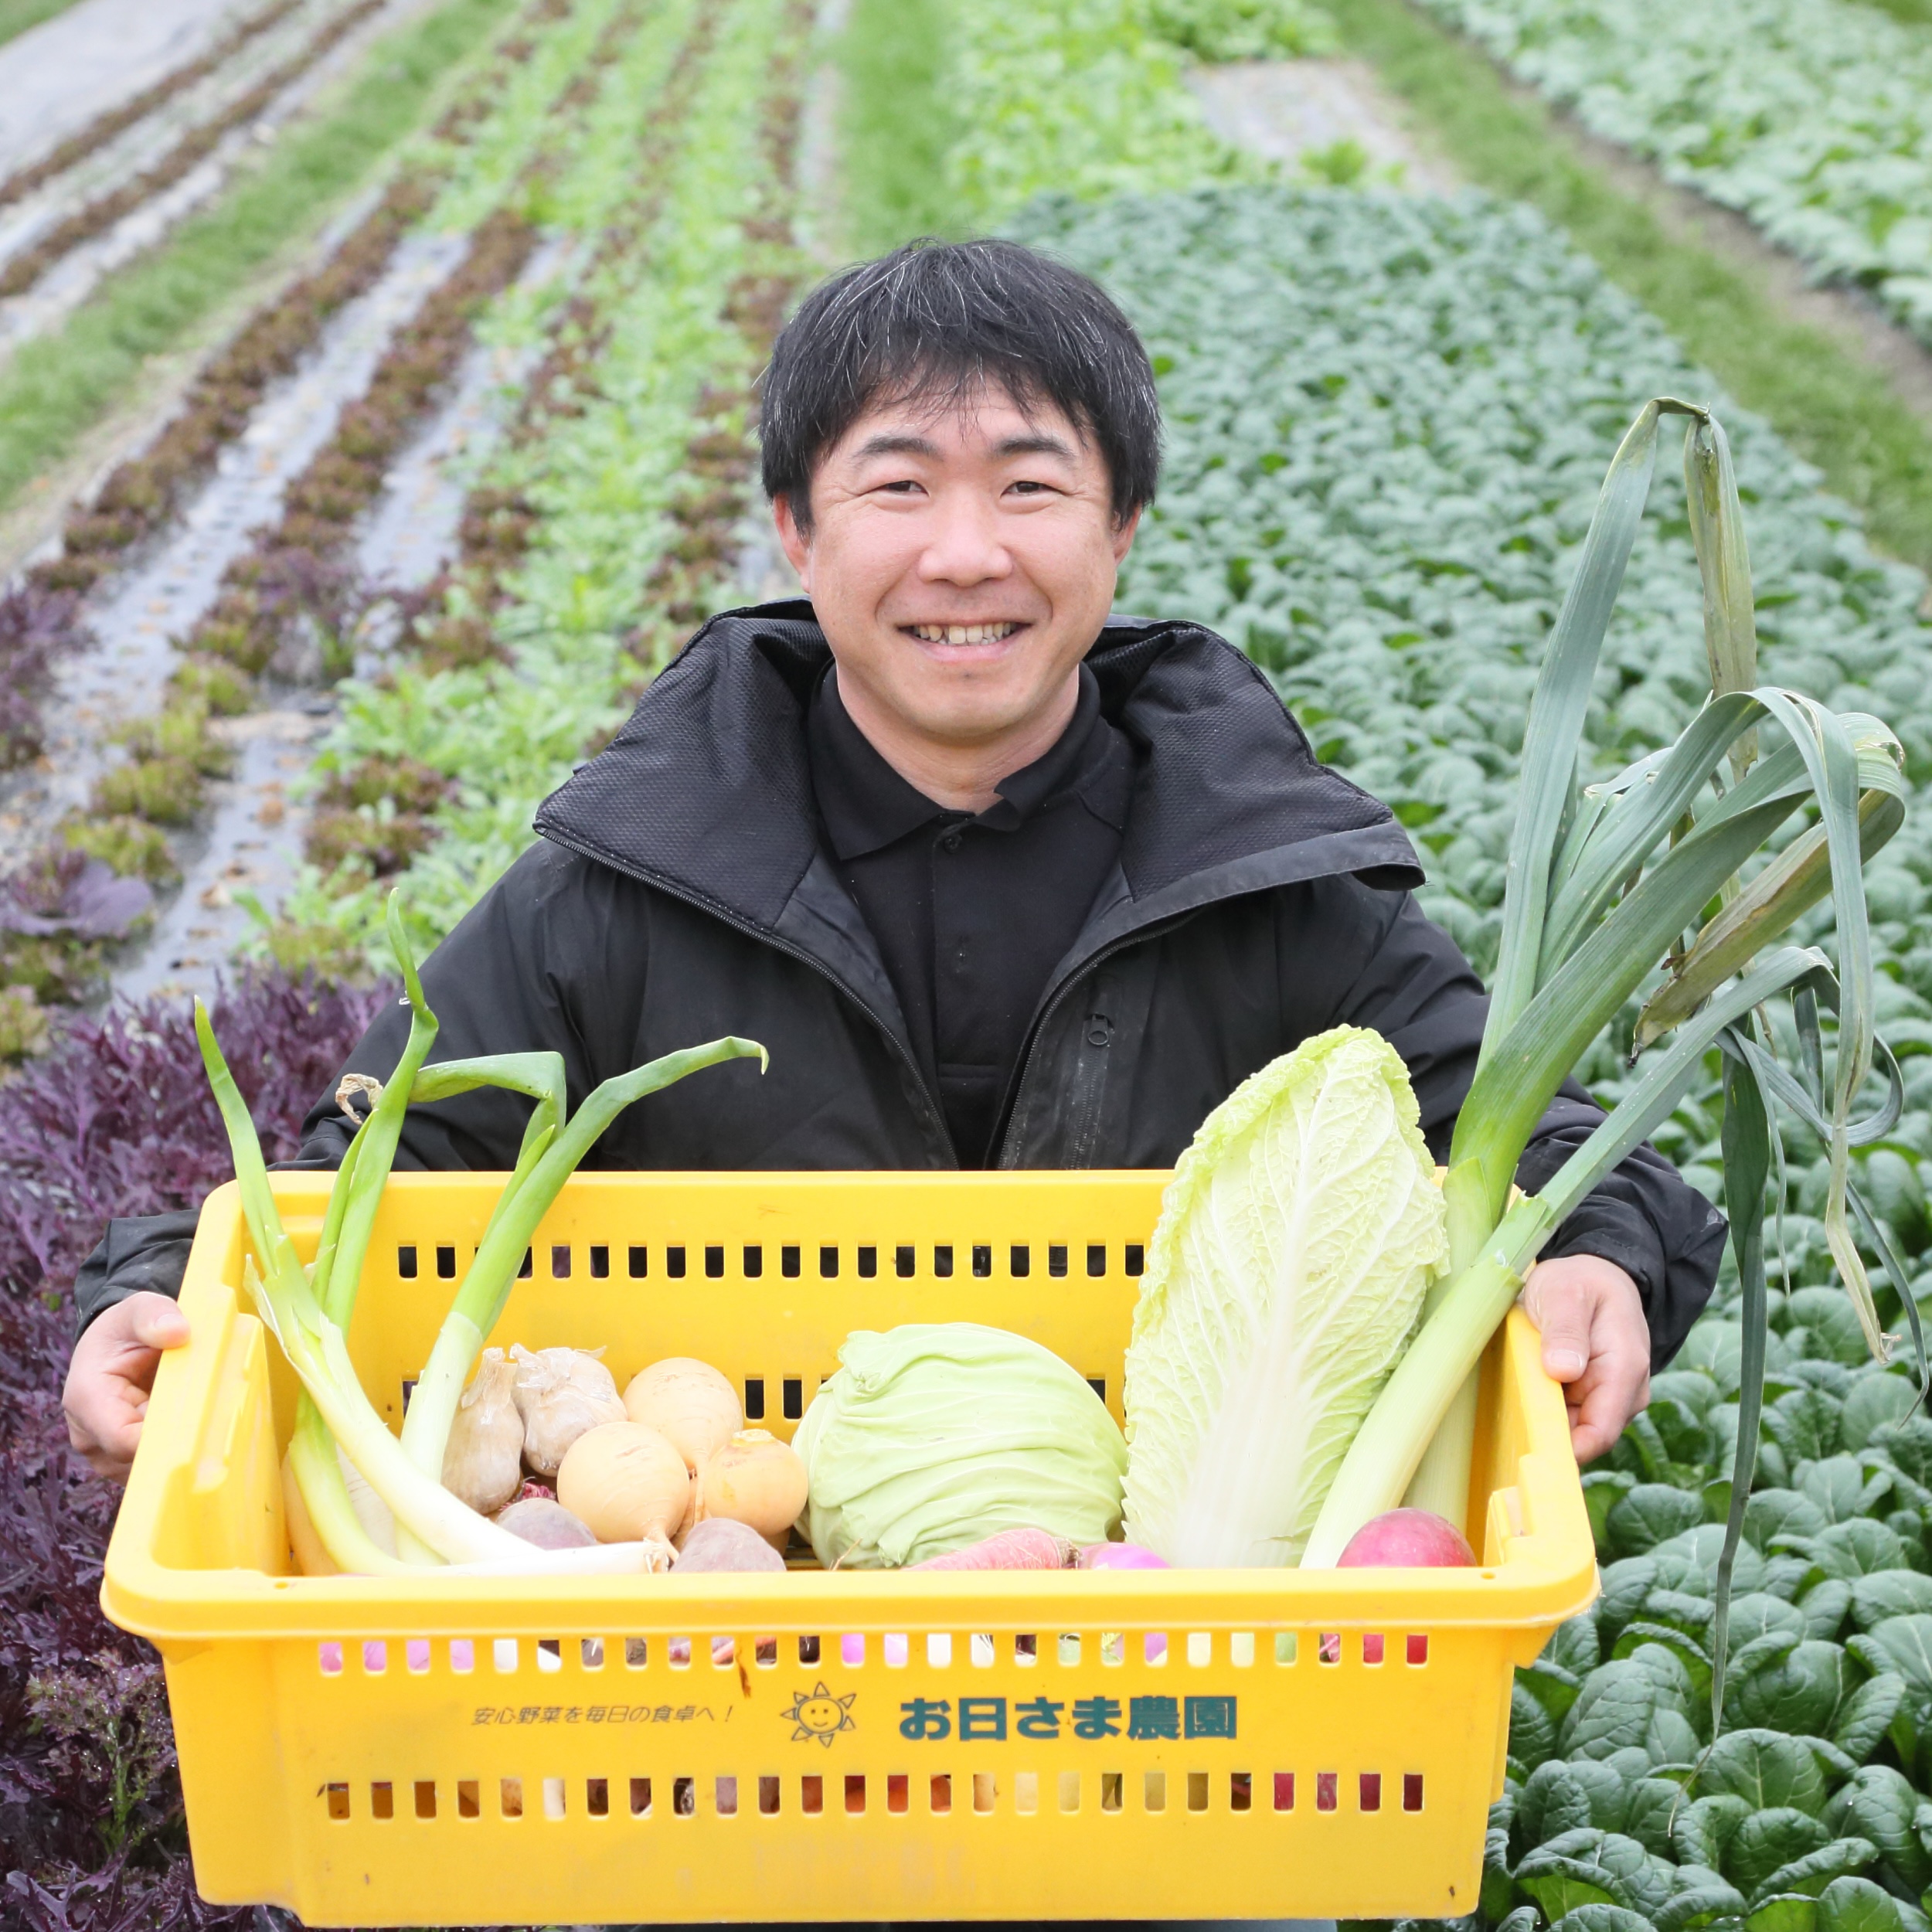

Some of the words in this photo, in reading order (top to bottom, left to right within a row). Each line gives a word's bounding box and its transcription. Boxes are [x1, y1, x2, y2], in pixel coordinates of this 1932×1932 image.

[471, 1705, 734, 1726] 安心野菜を毎日の食卓へ！
[899, 1696, 1236, 1741] お日さま農園
